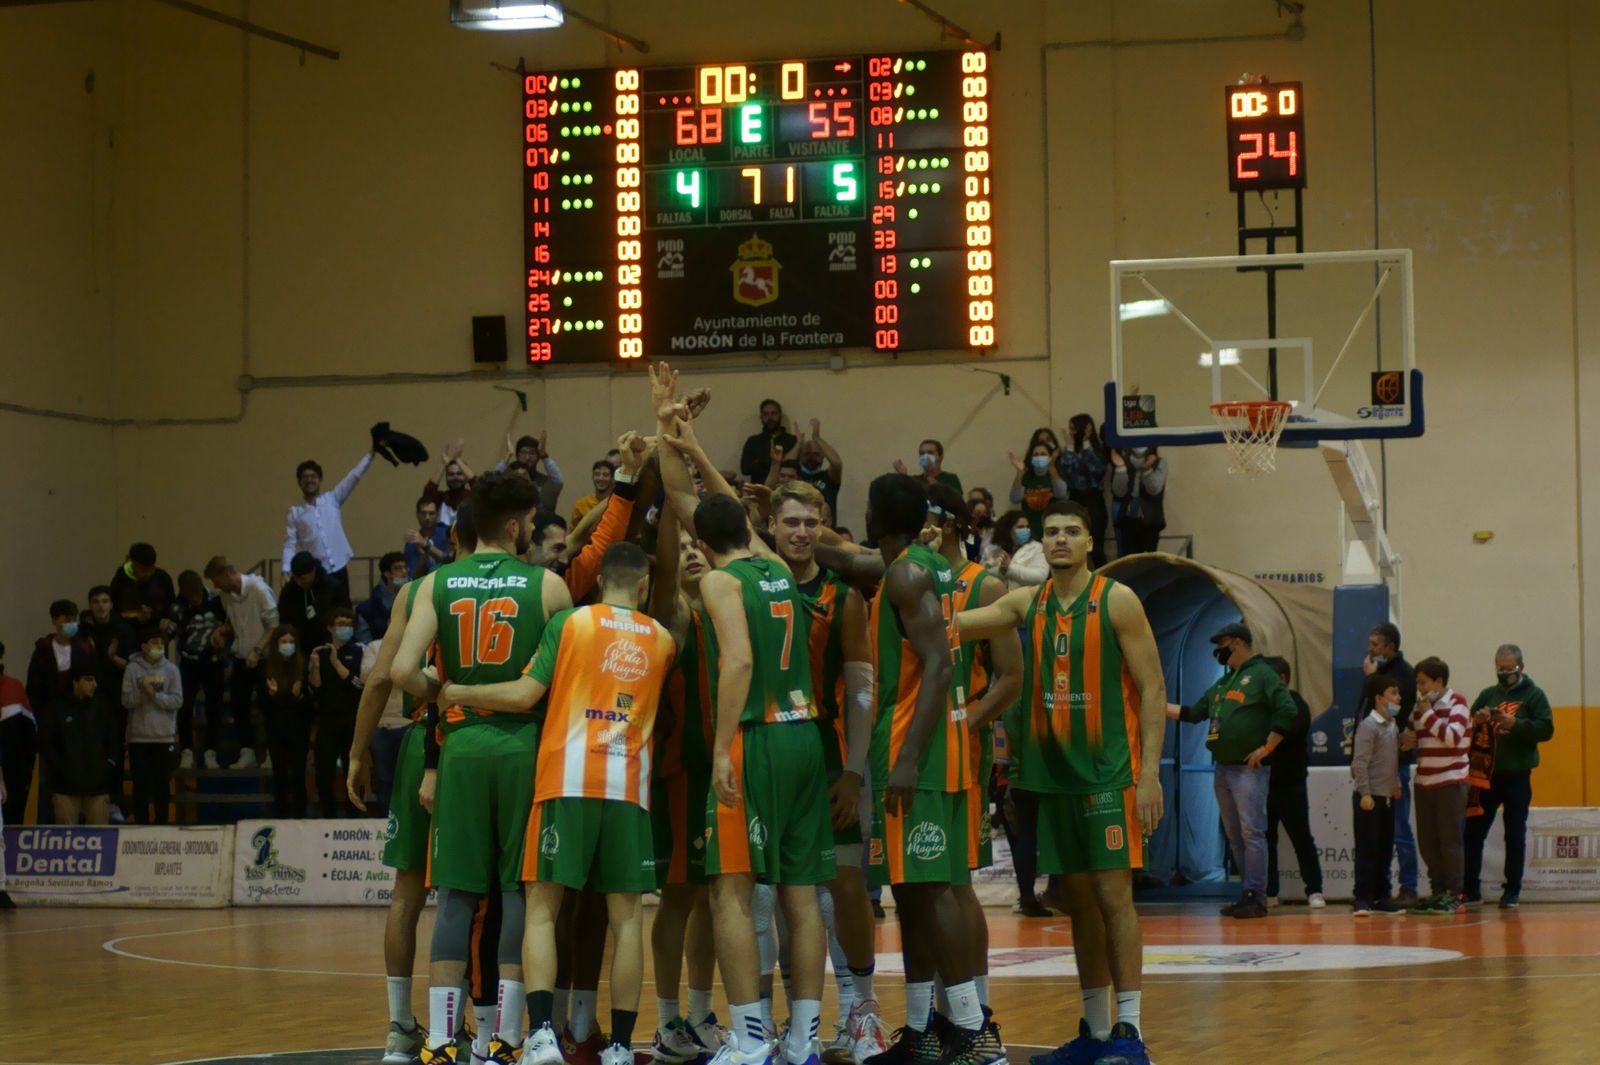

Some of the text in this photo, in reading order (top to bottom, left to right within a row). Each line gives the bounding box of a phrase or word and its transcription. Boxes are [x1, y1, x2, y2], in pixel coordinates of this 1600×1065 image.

[869, 58, 891, 76] 02
[701, 63, 804, 104] 00: 0
[870, 82, 892, 101] 03
[526, 100, 547, 118] 03
[1279, 90, 1295, 115] 0
[741, 105, 762, 143] E
[809, 102, 855, 138] 55
[870, 106, 892, 125] 08
[526, 124, 548, 142] 06
[676, 108, 722, 145] 68
[789, 140, 849, 155] VISITANTE
[878, 132, 893, 149] 11
[526, 148, 548, 167] 07
[669, 149, 706, 162] LOCAL
[734, 145, 770, 158] PARTE
[1237, 131, 1296, 178] 24
[878, 156, 893, 174] 13
[533, 172, 548, 190] 10
[677, 171, 699, 208] 4
[742, 168, 761, 204] 7
[787, 166, 793, 203] 1
[833, 163, 856, 200] 5
[879, 180, 894, 199] 15
[534, 197, 549, 213] 11
[770, 208, 794, 219] FALTA
[814, 205, 850, 218] FALTAS
[873, 205, 895, 224] 29
[657, 212, 692, 224] FALTAS
[720, 210, 753, 220] DORSAL
[534, 222, 549, 238] 14
[875, 230, 895, 249] 33
[534, 244, 549, 263] 16
[881, 255, 896, 273] 13
[528, 269, 550, 287] 24
[875, 280, 897, 299] 00
[528, 294, 550, 312] 25
[694, 312, 820, 330] Ayuntamiento de
[875, 305, 898, 324] 00
[529, 318, 550, 336] 27
[672, 328, 843, 349] MORÓN de la Frontera
[876, 330, 898, 348] 00
[530, 342, 550, 361] 33
[447, 576, 528, 588] GONZALEZ
[450, 597, 518, 668] 16
[770, 600, 793, 670] 7
[18, 830, 102, 850] Clínica
[332, 830, 372, 841] MORÓN:
[1105, 825, 1123, 849] 0
[16, 853, 102, 873] Dental
[332, 851, 375, 860] ARAHAL:
[331, 870, 392, 881] ÉCIJA: Avda.
